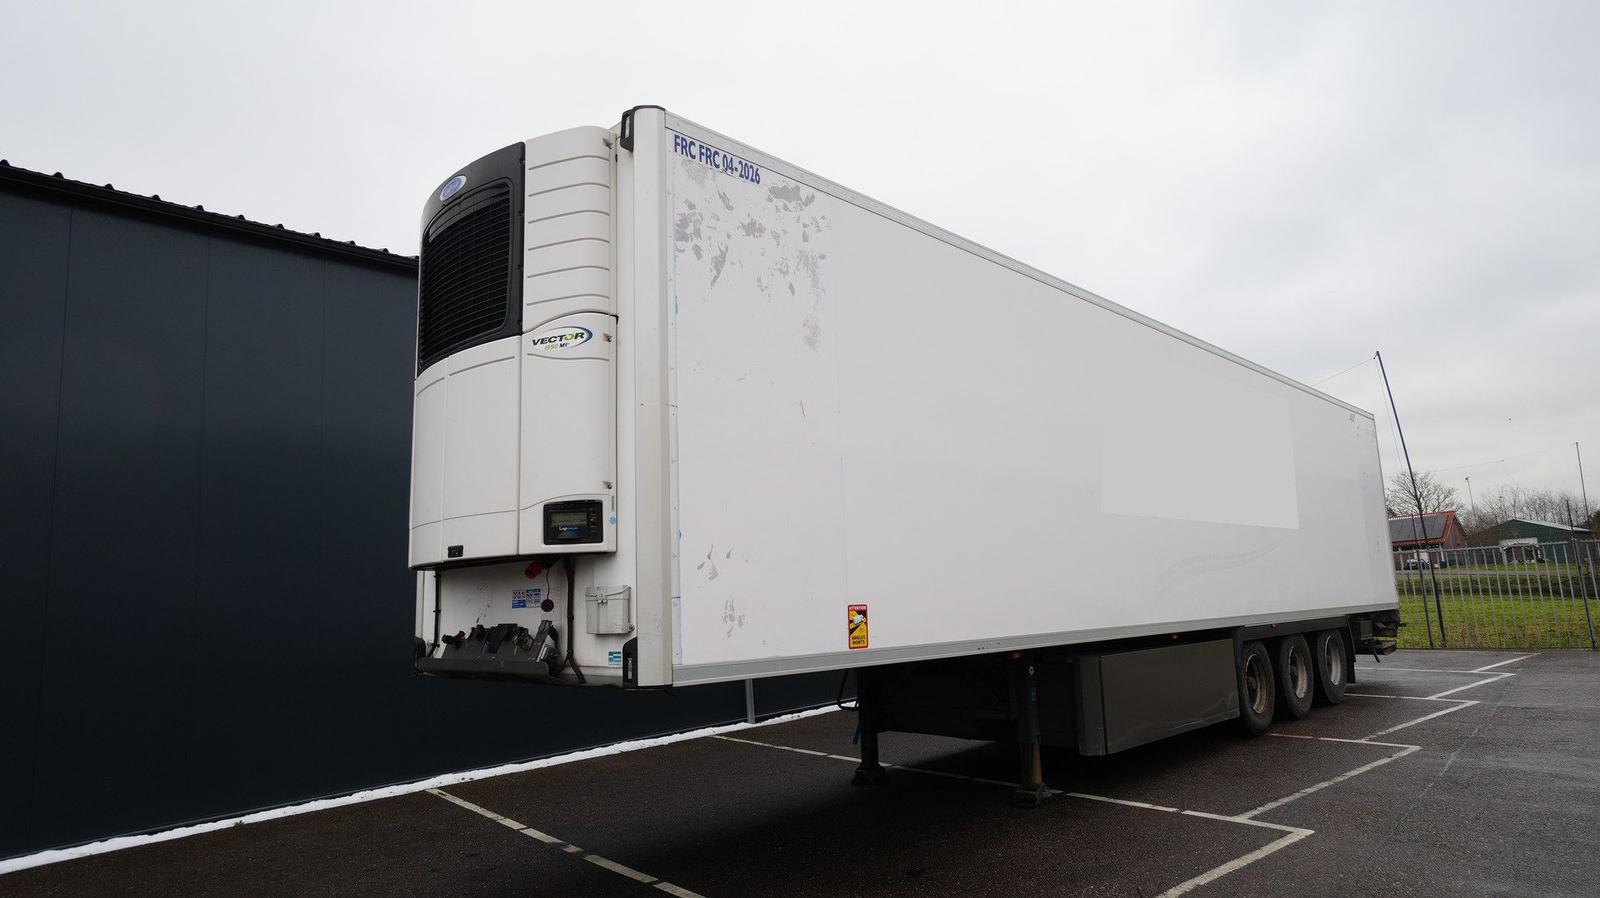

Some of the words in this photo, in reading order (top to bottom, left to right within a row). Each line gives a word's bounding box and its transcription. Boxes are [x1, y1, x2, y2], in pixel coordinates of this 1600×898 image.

[674, 134, 696, 160] FRC
[699, 144, 720, 169] FRC
[722, 154, 761, 185] 04-2026
[532, 332, 585, 346] VECTOR
